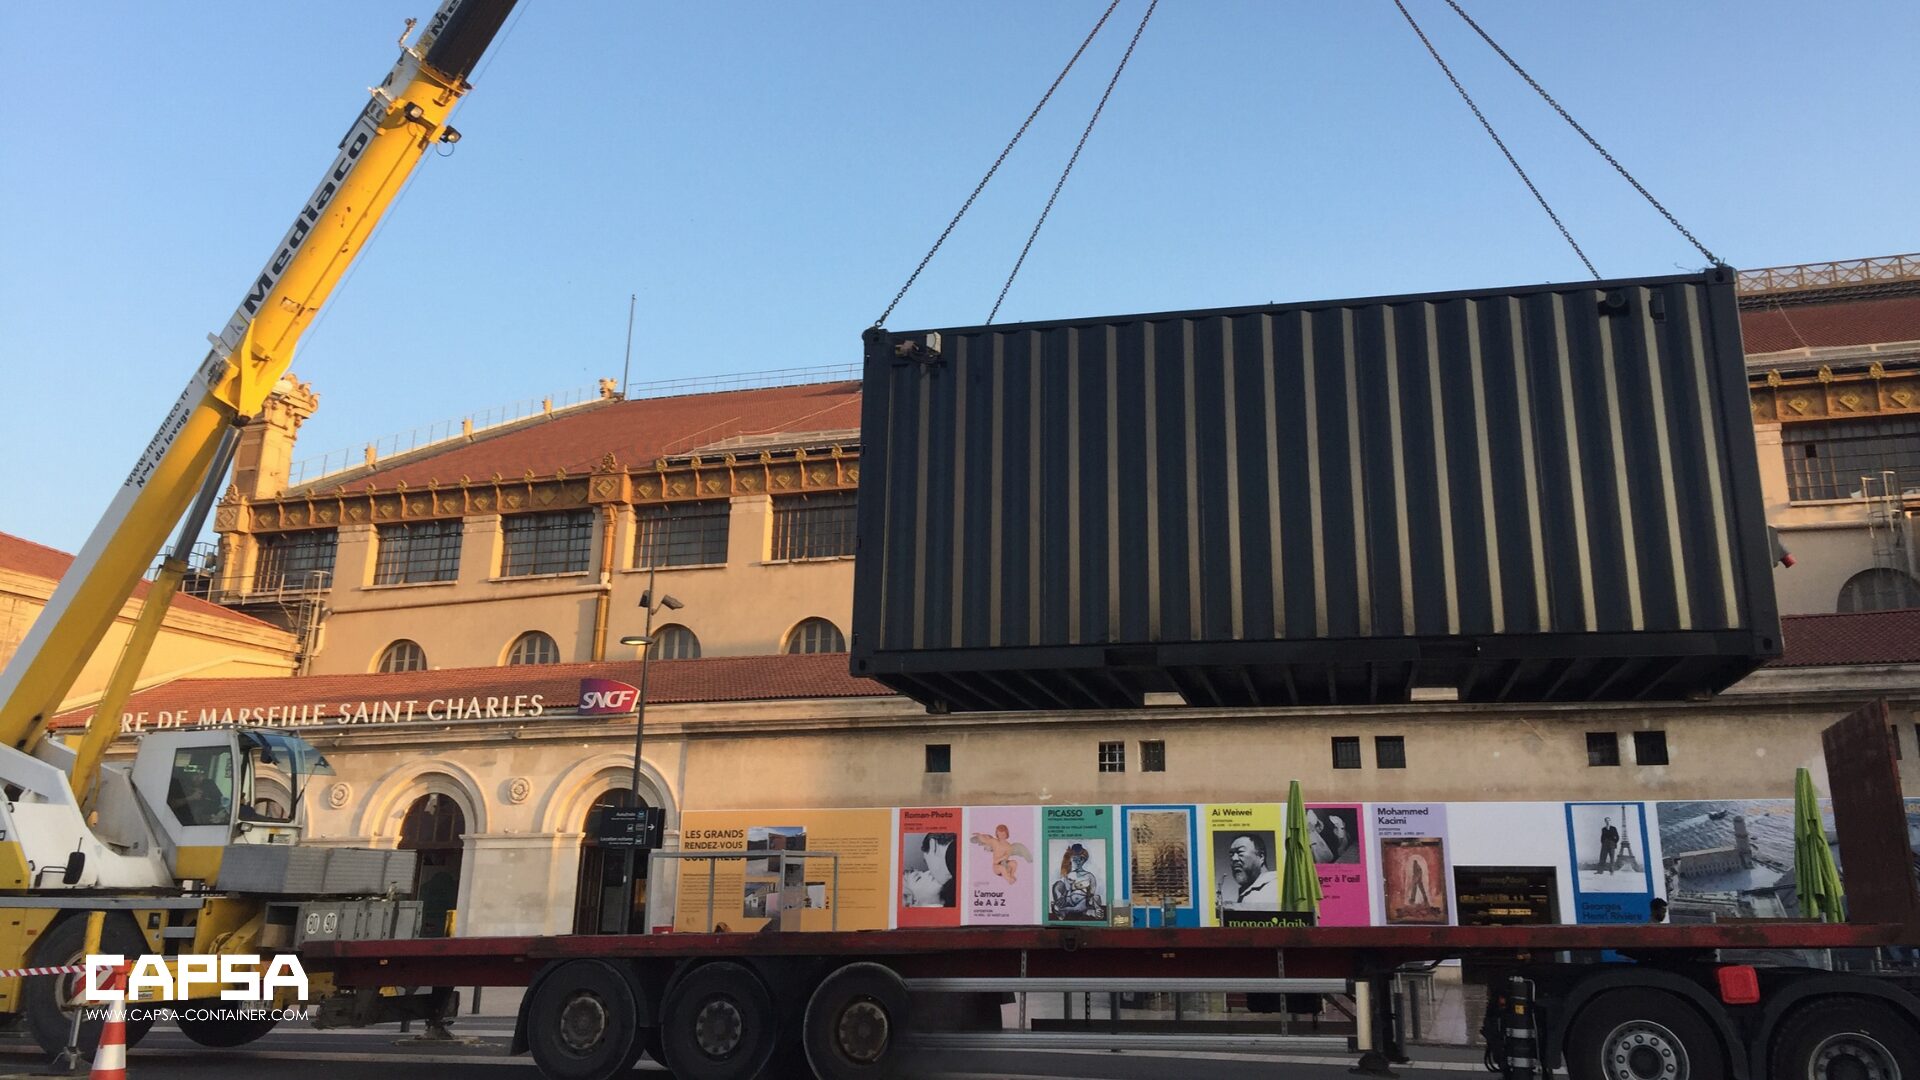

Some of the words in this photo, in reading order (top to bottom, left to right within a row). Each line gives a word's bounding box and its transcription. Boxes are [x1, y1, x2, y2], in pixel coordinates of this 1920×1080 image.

[243, 132, 368, 315] Mediaco
[124, 387, 189, 487] www.mediaco.fr
[155, 446, 165, 462] du
[164, 408, 191, 446] levage
[580, 690, 635, 709] SNCF
[157, 709, 188, 730] DE
[199, 704, 326, 727] MARSEILLE
[337, 700, 418, 725] SAINT
[427, 694, 544, 721] CHARLES
[904, 811, 953, 819] Roman-Photo
[1047, 809, 1083, 818] PICASSO
[1212, 808, 1221, 816] Ai
[1223, 808, 1253, 816] Weiwei
[1377, 807, 1429, 816] Mohammed
[1378, 816, 1407, 825] Kacimi
[685, 831, 701, 839] LES
[703, 829, 744, 839] GRANDS
[684, 841, 743, 850] RENDEZ-VOUS
[1318, 874, 1332, 885] ger
[974, 890, 1004, 898] L'amour
[973, 899, 984, 907] de
[985, 899, 992, 907] A
[994, 899, 999, 907] à
[1000, 899, 1006, 907] Z
